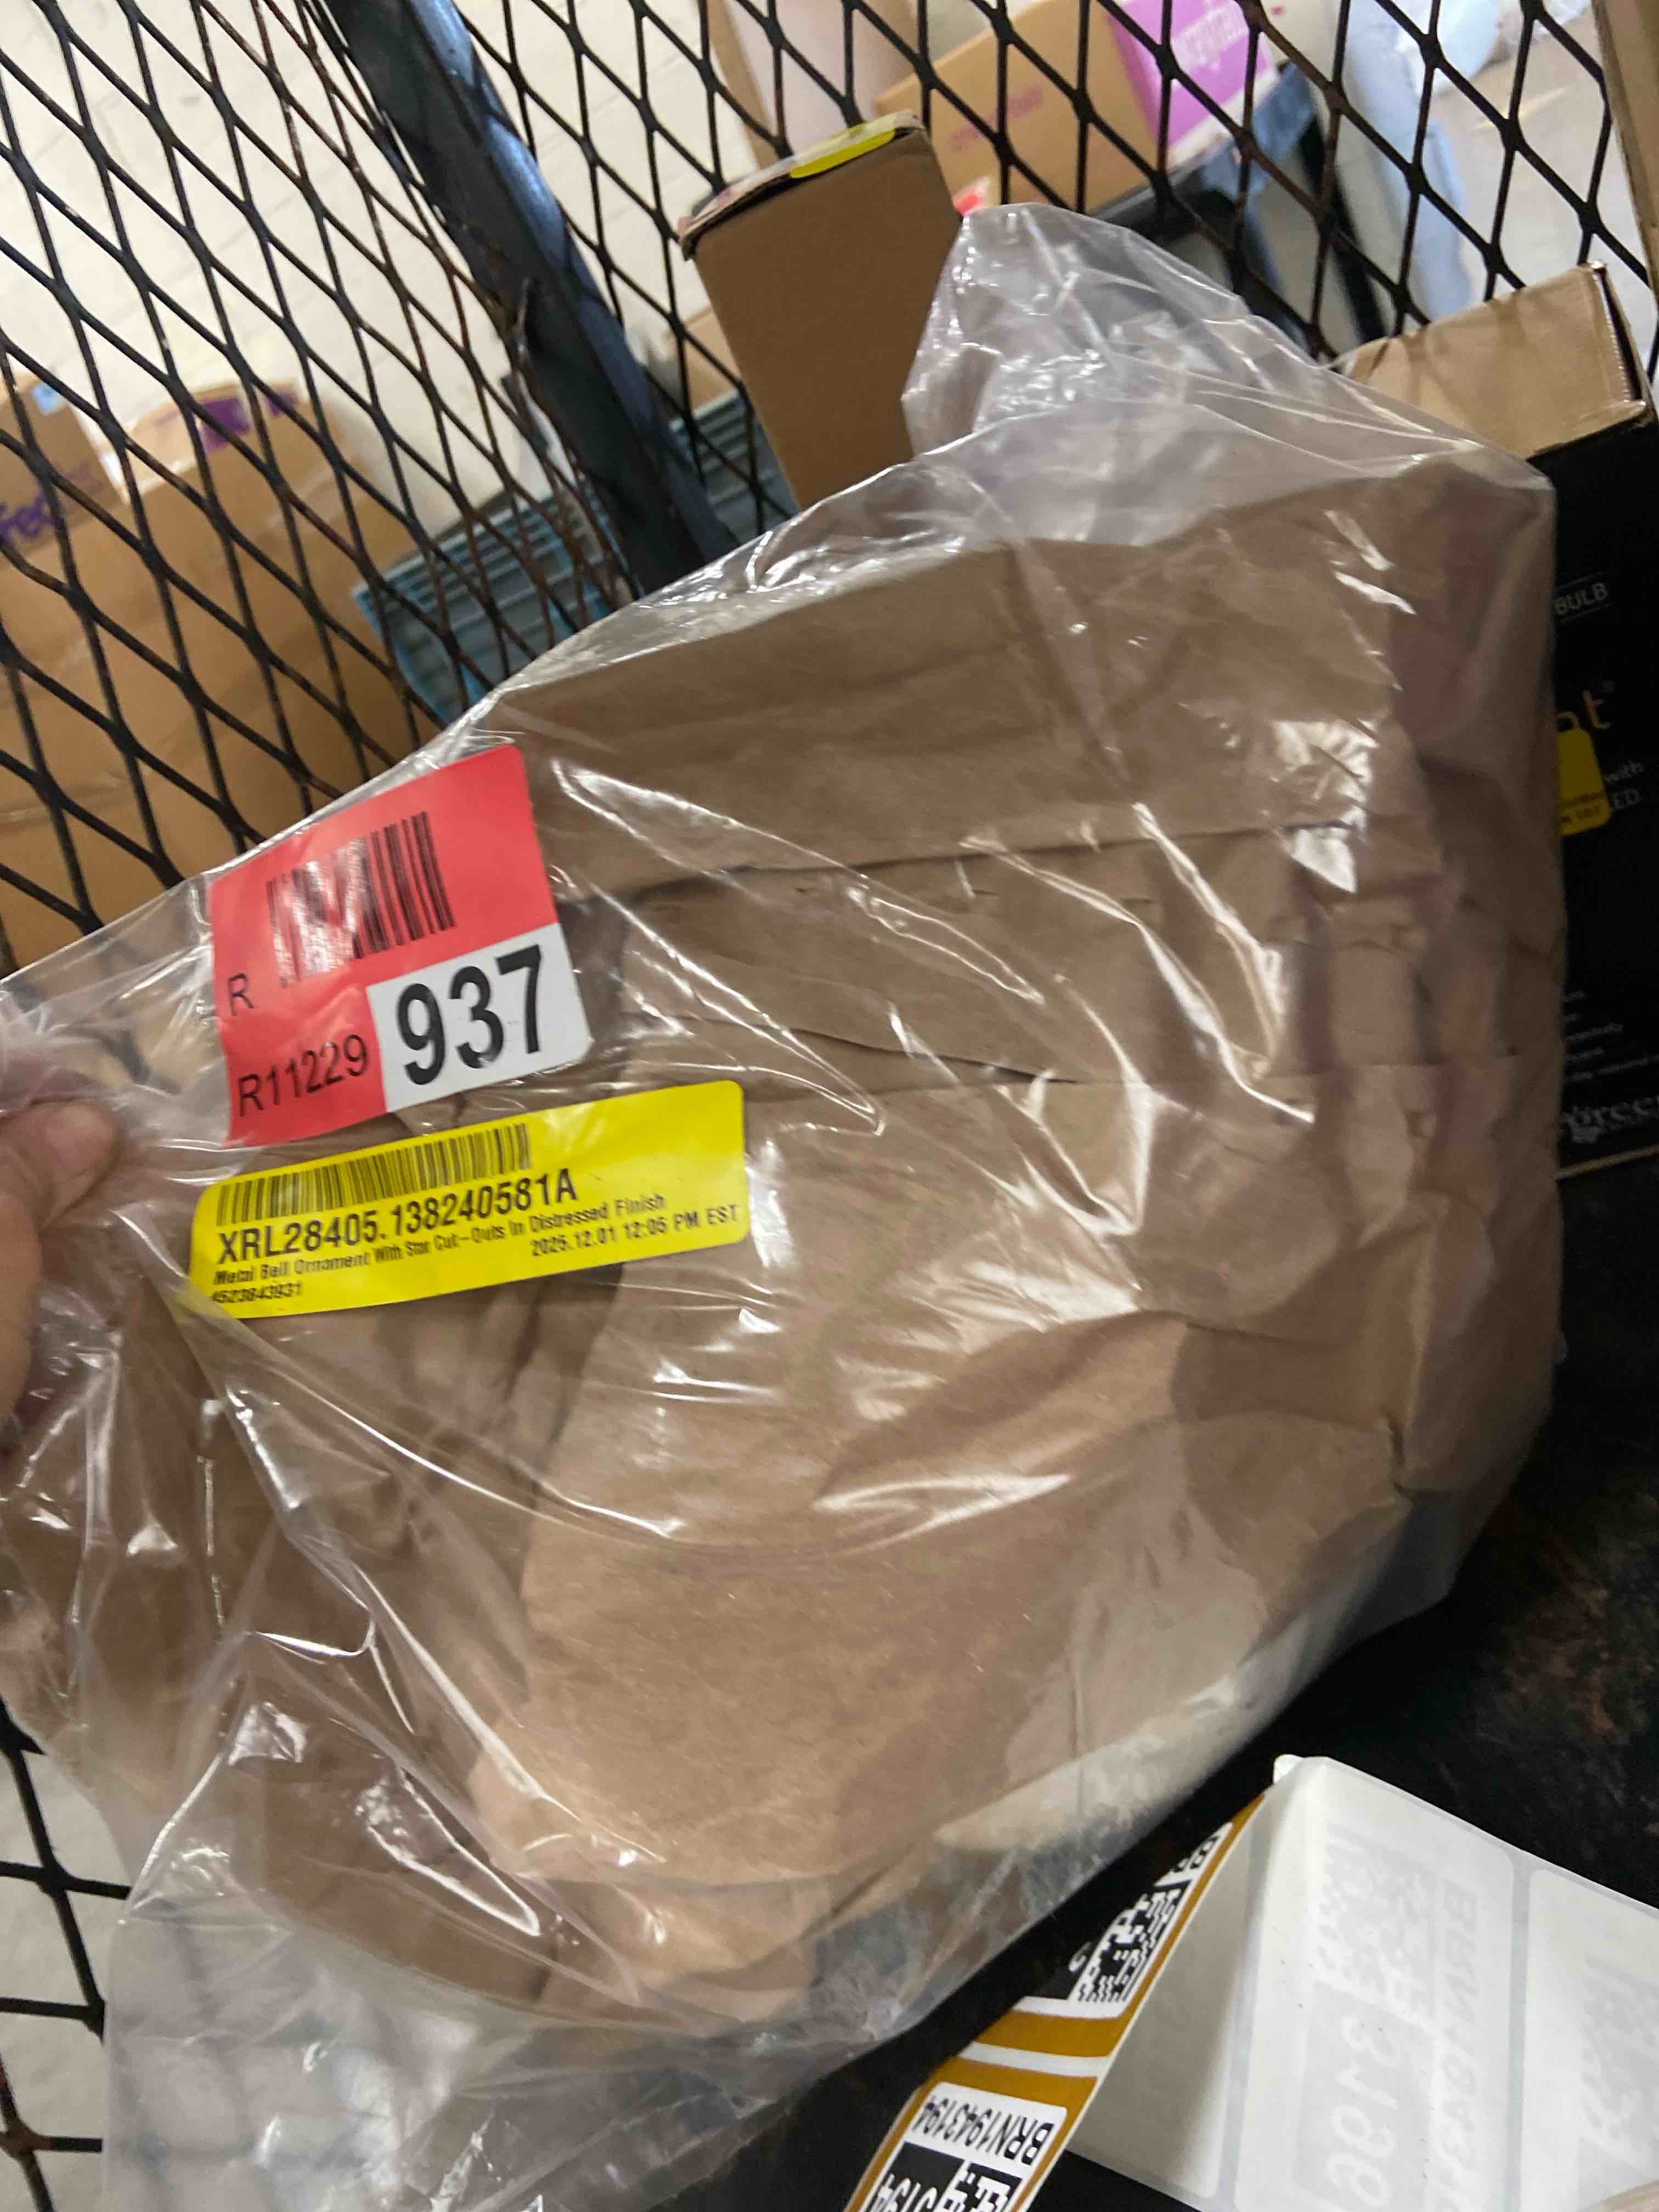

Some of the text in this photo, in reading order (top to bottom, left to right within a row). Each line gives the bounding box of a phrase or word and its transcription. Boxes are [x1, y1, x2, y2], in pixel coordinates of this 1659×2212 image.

[1554, 582, 1608, 615] BULB
[227, 972, 255, 1016] R
[396, 944, 542, 1086] 937
[238, 1034, 369, 1118] R11229
[214, 1266, 255, 1285] Metal
[295, 1251, 369, 1274] Ornament
[373, 1244, 403, 1262] With
[404, 1241, 430, 1257] Star
[509, 1220, 526, 1235] In
[529, 1203, 608, 1233] Distressed
[614, 1193, 665, 1217] Finish
[218, 1168, 577, 1265] XRL28405.138240581A
[531, 1203, 738, 1257] 2025.12.01 12:05 PM EST
[911, 2095, 1055, 2165] BRN1943194
